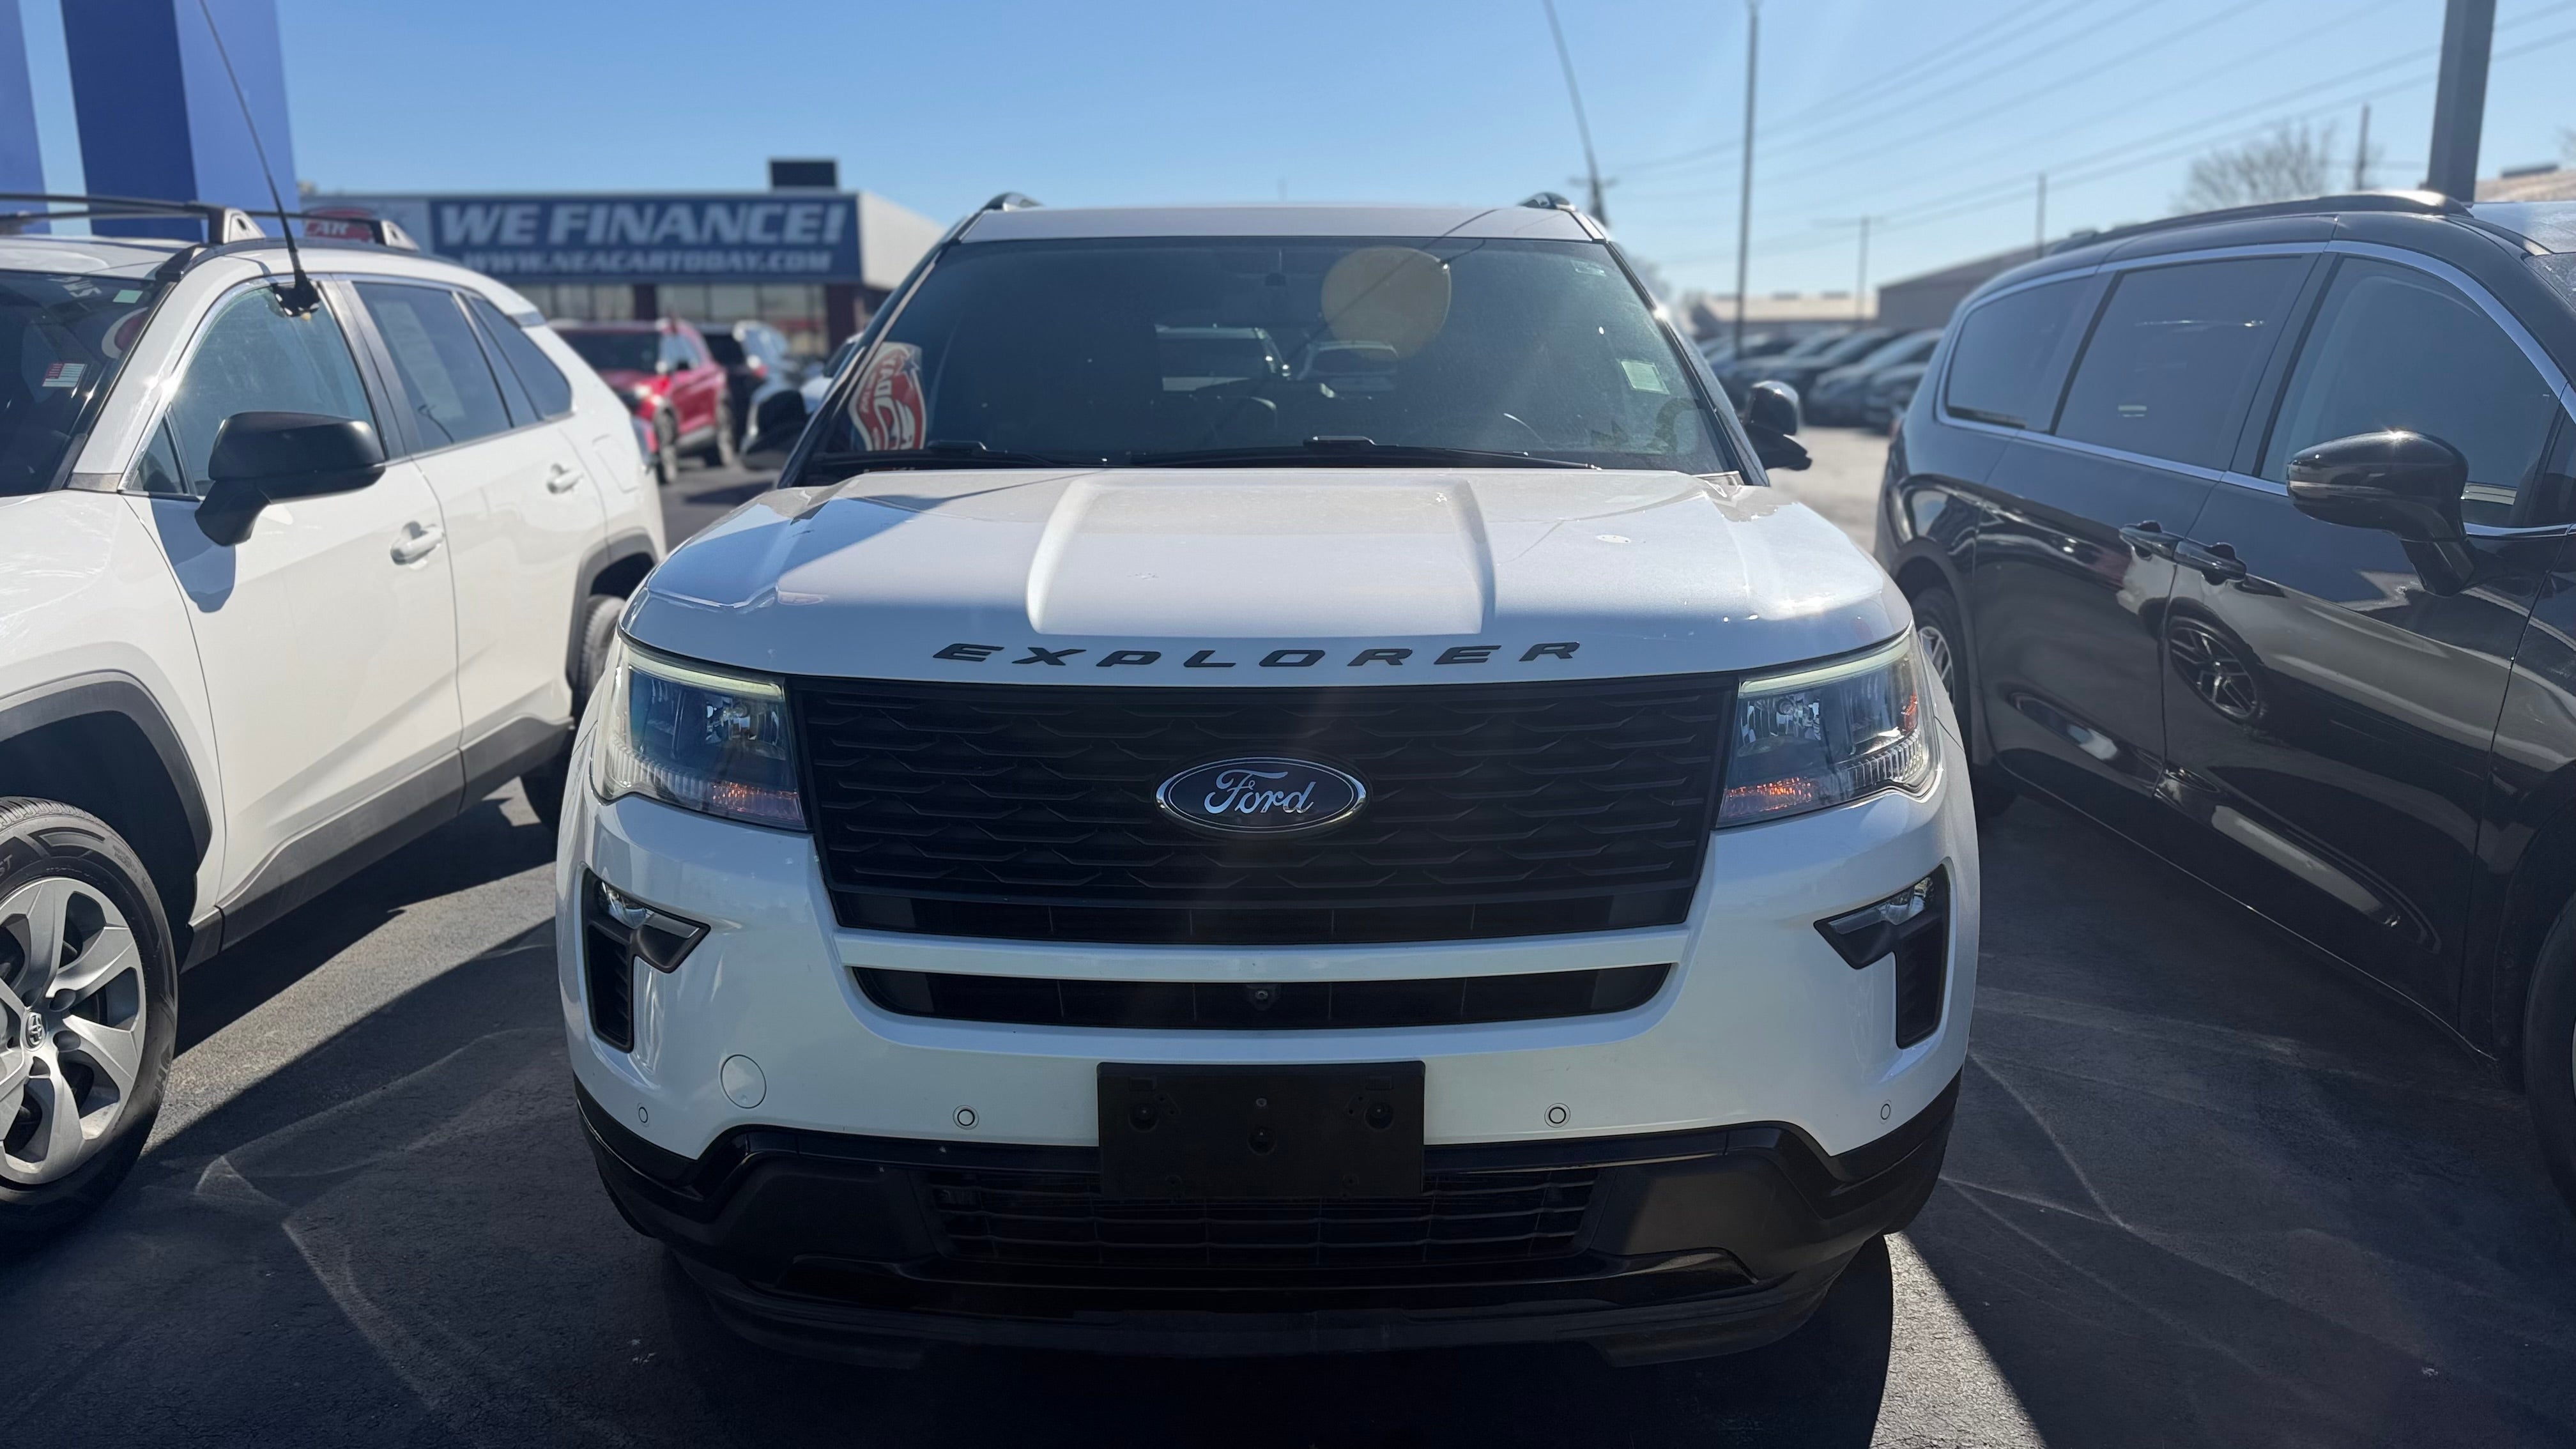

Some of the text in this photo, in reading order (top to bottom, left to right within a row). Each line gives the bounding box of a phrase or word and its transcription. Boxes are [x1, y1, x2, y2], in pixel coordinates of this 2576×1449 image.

[441, 203, 847, 244] WE FINANCE!
[933, 641, 1581, 668] EXPLORER
[1204, 769, 1317, 815] Ford
